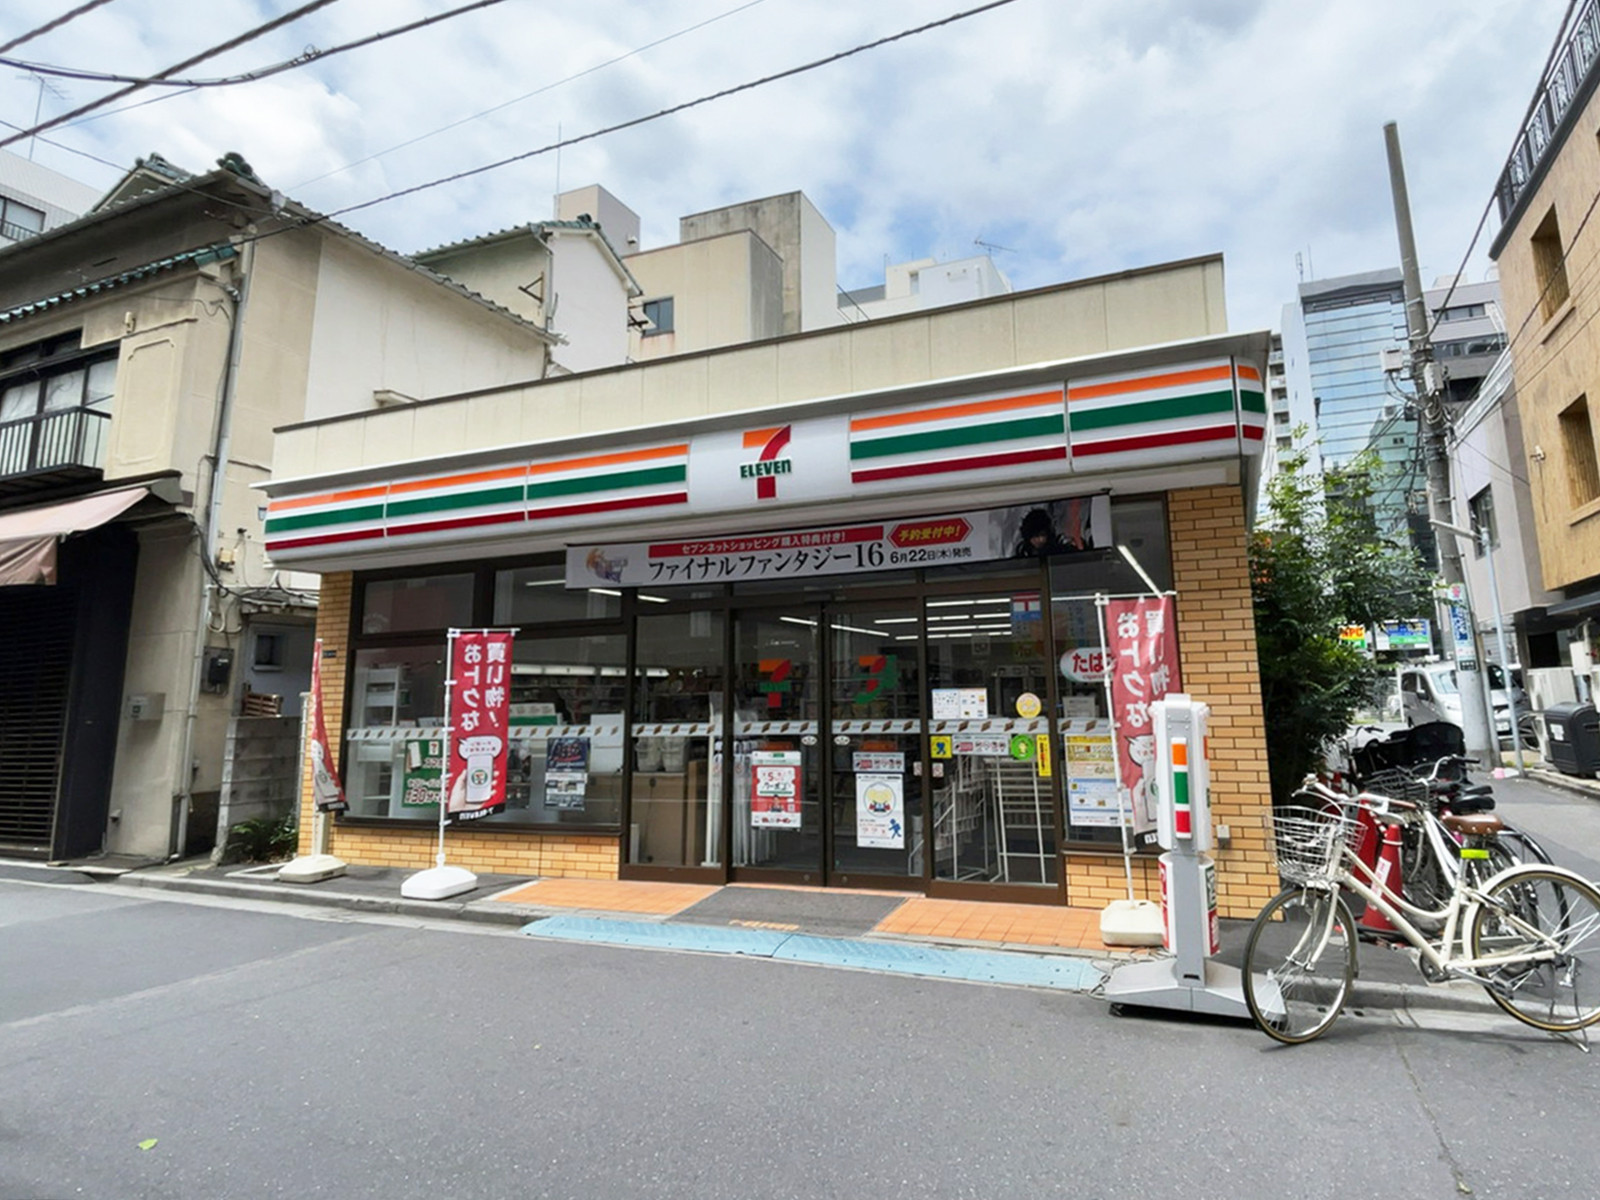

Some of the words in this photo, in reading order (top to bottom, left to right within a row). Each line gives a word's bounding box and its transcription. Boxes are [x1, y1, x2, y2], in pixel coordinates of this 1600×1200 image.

[648, 542, 885, 581] ファイナルファンタジー16
